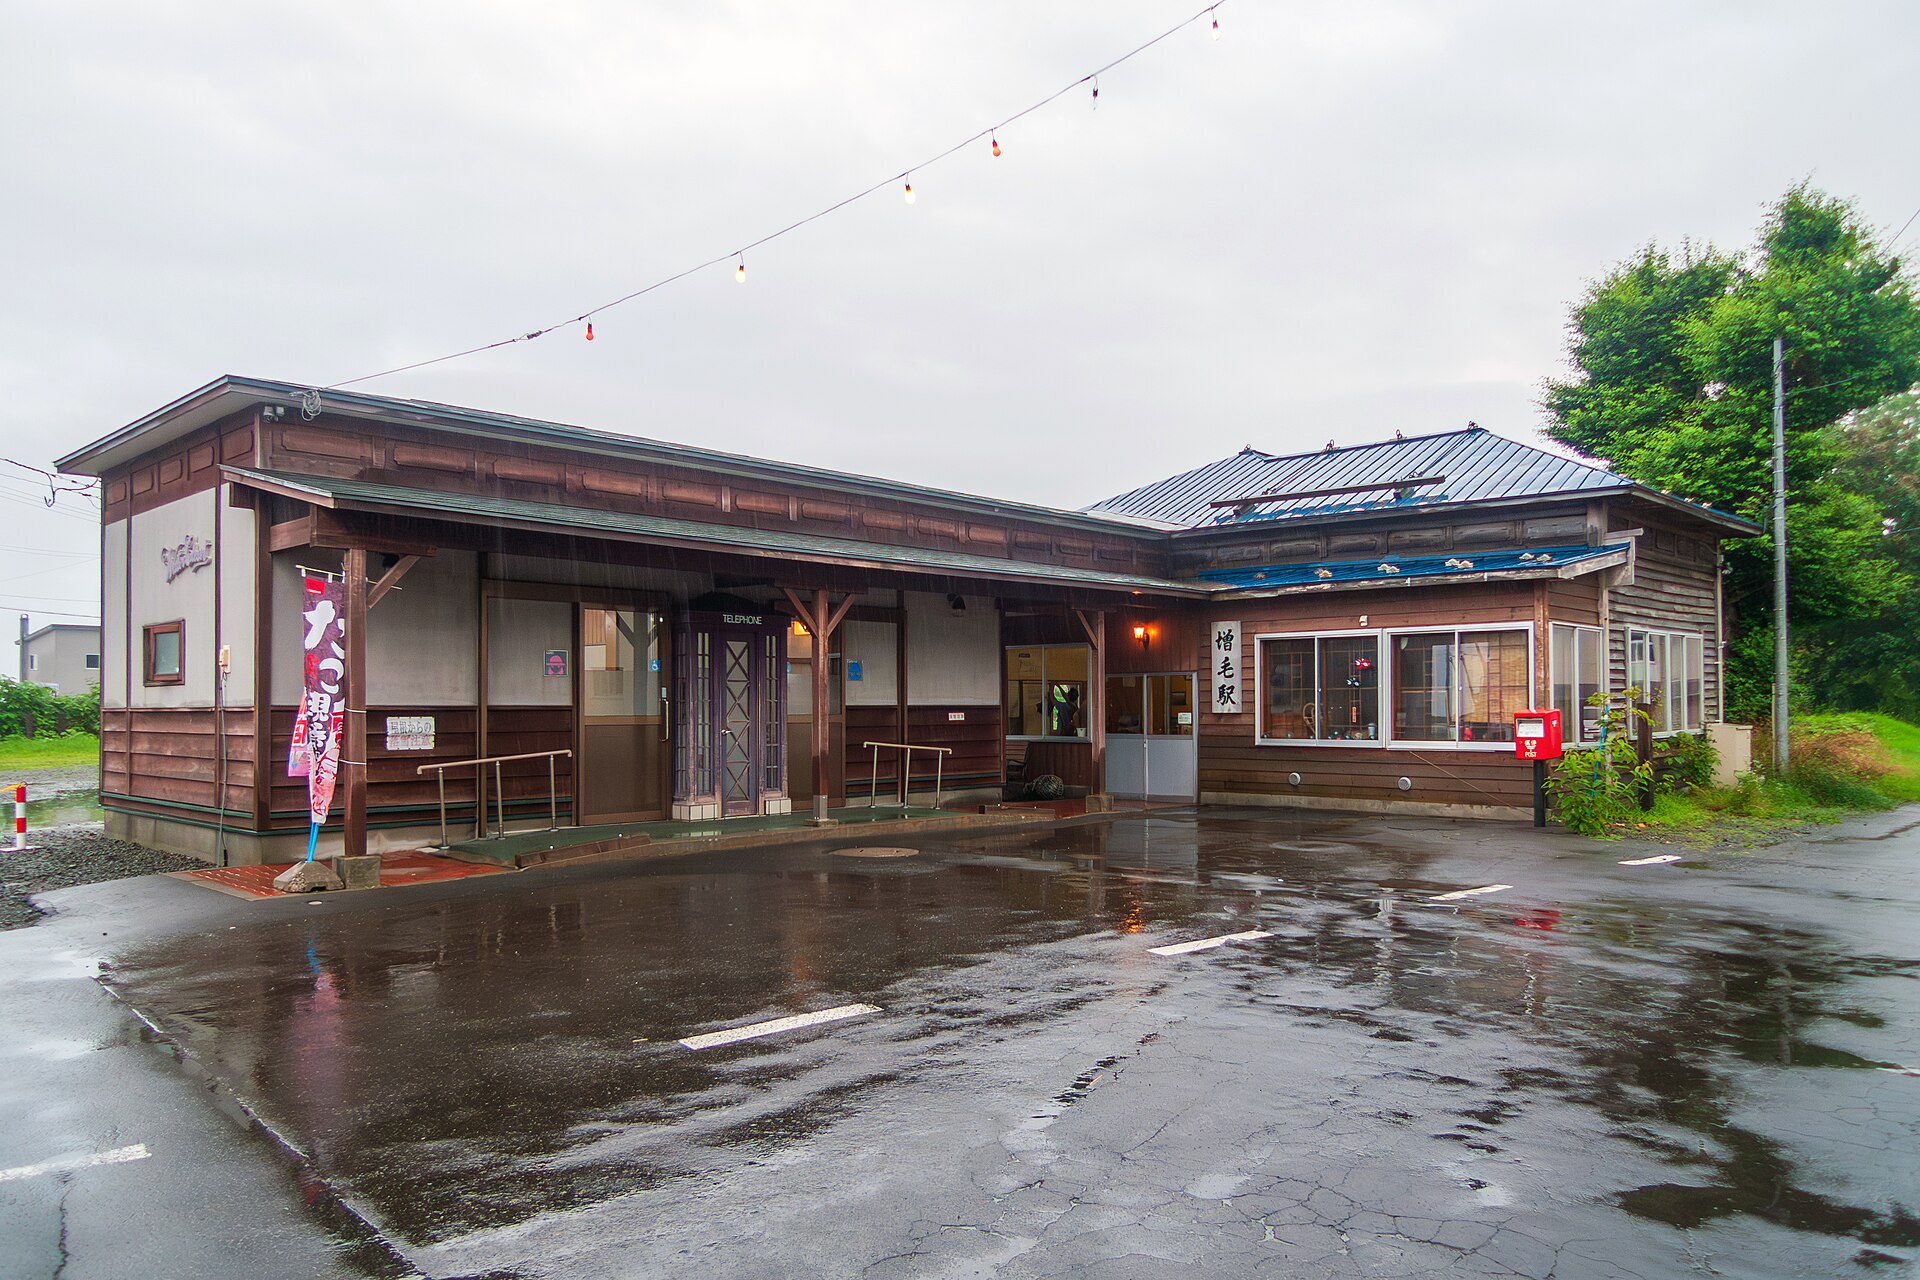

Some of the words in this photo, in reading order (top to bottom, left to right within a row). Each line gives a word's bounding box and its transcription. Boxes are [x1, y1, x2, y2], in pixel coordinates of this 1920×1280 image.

[722, 613, 763, 625] TELEPHONE
[1215, 628, 1237, 706] 増毛駅
[390, 720, 432, 735] 屋根からの
